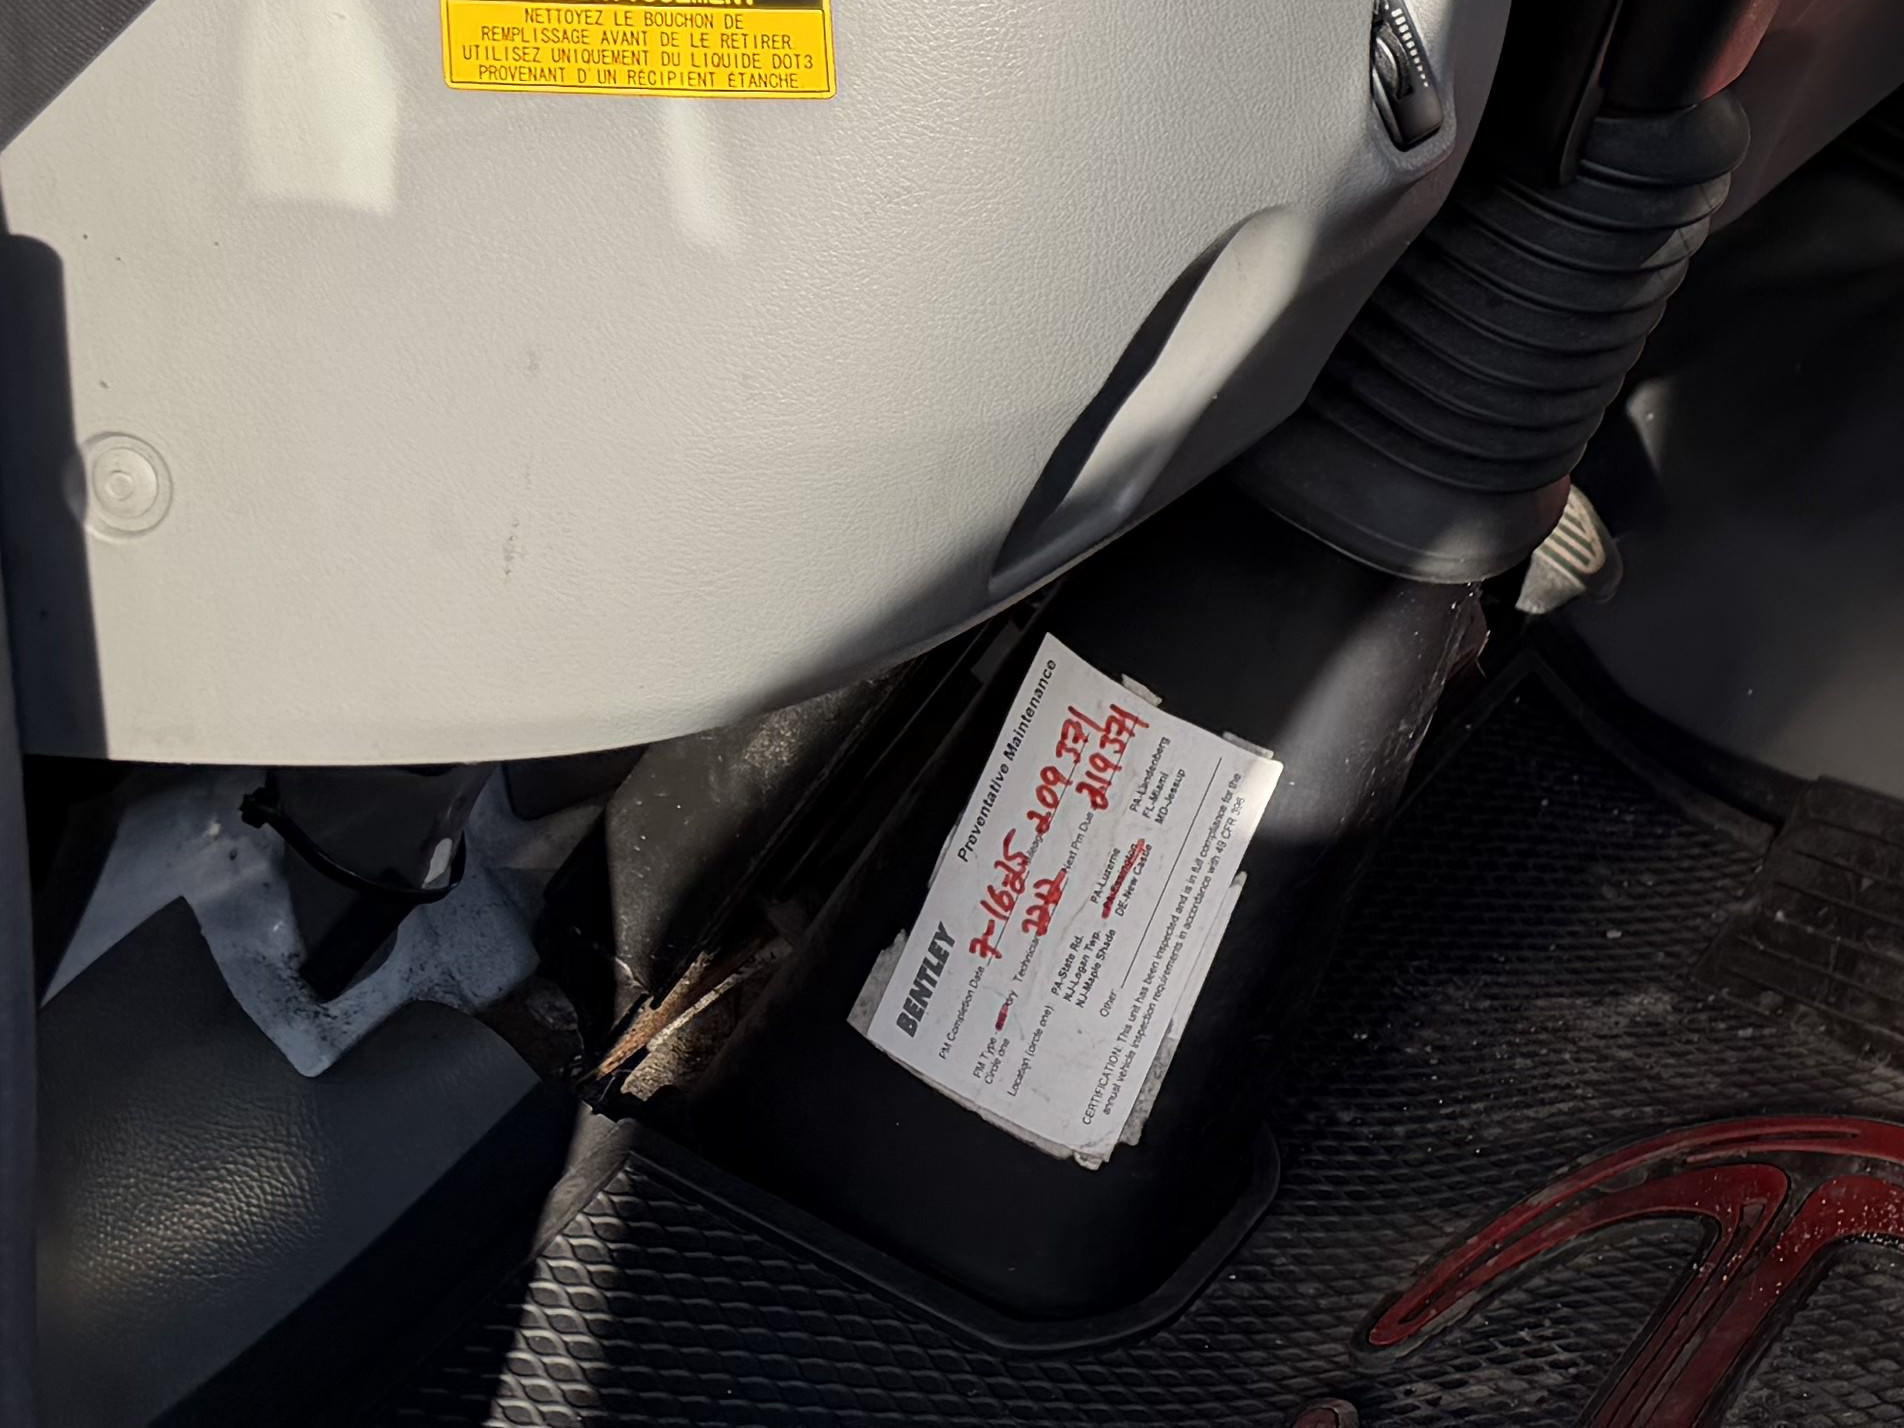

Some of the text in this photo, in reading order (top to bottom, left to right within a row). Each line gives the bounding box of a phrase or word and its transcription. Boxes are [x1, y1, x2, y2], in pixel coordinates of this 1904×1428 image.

[523, 6, 744, 30] NETTOYEZ LE BOUCHON DE
[480, 24, 793, 51] REMPLISSAGE AVANT DE LE RETIRER
[461, 43, 814, 70] UTILISEZ UNIQUEMENT DU LIQUIDE DOT3
[478, 64, 566, 84] PROVENANT
[626, 67, 716, 88] RÉCIPIENT
[955, 658, 1057, 863] Preventative Maintenance
[894, 920, 956, 1038] BENTLEY
[937, 964, 985, 1060] PM Completion Date
[977, 1035, 998, 1060] Type
[996, 1037, 1010, 1057] one
[971, 1059, 986, 1079] PM
[1005, 1056, 1031, 1097] Location
